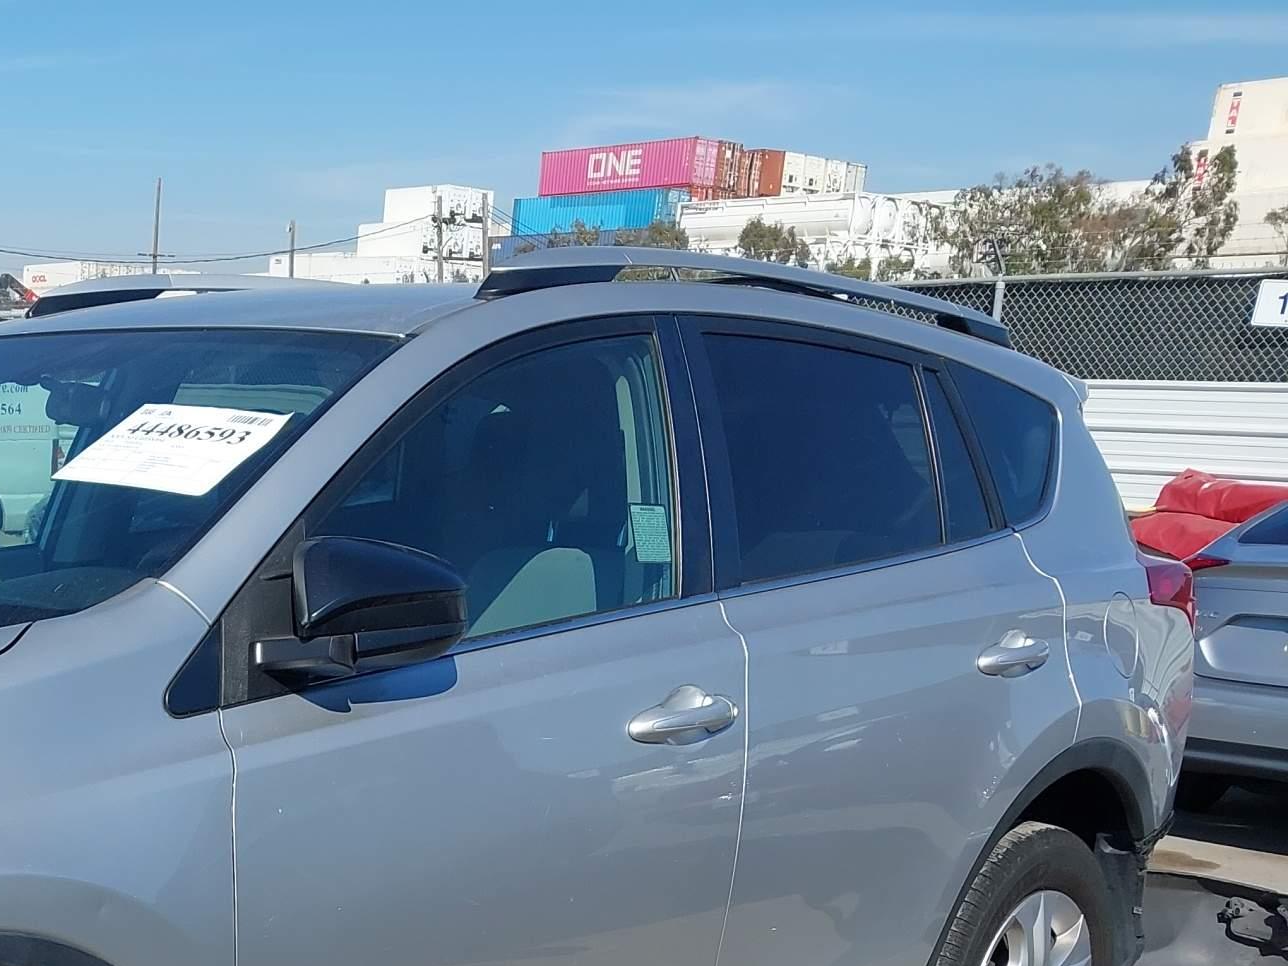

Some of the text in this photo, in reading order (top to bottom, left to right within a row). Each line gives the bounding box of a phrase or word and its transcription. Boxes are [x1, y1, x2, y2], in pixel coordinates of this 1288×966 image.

[587, 149, 642, 178] ONE
[14, 424, 51, 433] CERTIFIED
[127, 420, 252, 445] 44486593
